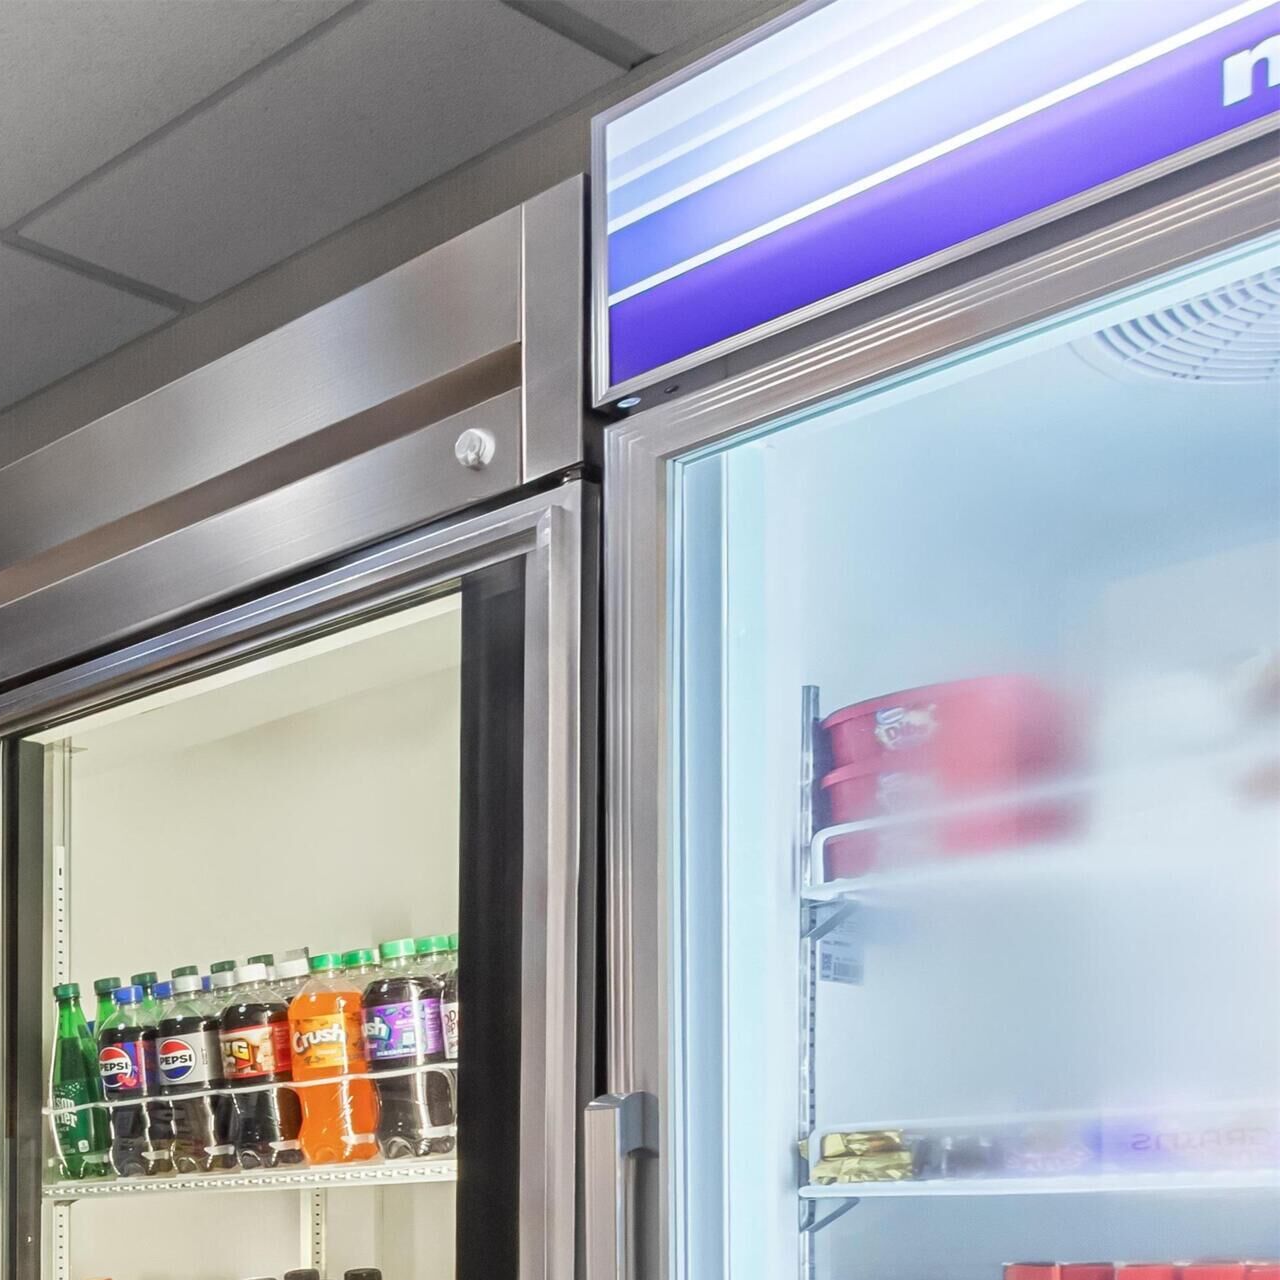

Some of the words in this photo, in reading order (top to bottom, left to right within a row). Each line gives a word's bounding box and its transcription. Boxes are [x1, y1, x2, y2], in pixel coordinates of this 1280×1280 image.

[294, 1024, 345, 1053] Crush
[160, 1054, 192, 1065] PEPSI
[100, 1062, 129, 1071] PEPSI
